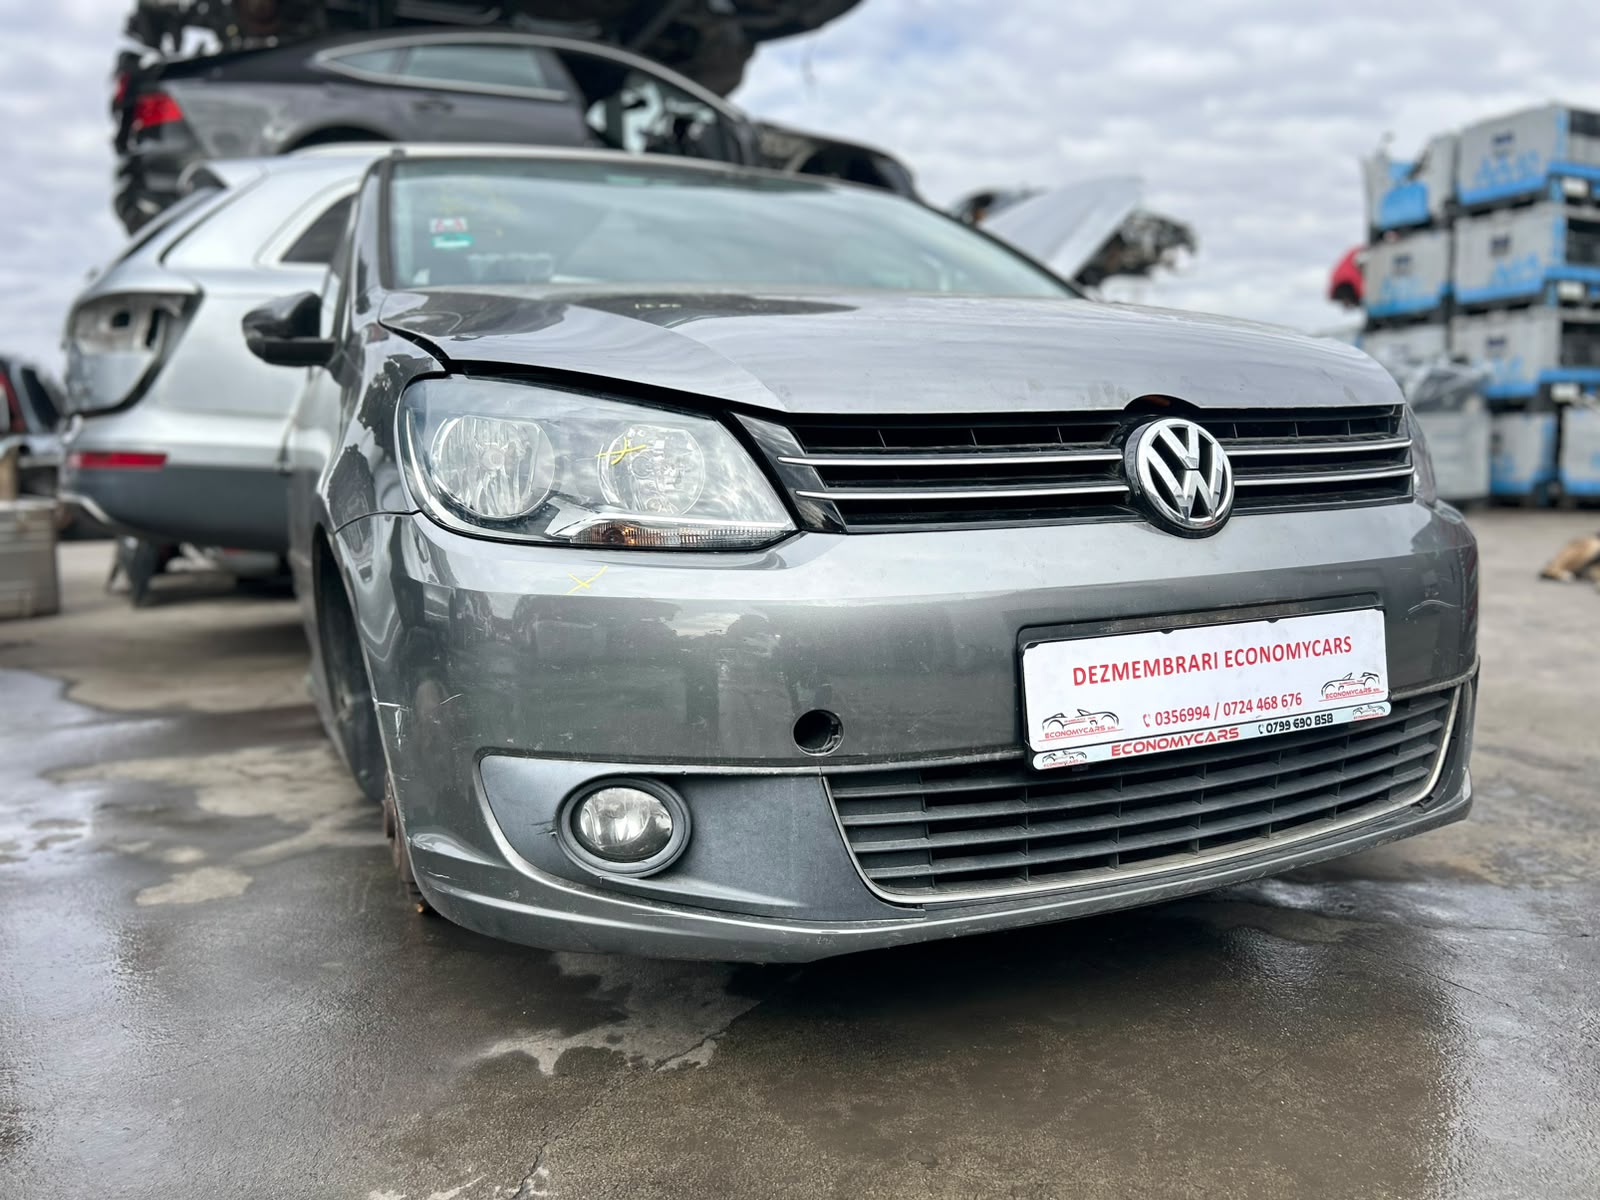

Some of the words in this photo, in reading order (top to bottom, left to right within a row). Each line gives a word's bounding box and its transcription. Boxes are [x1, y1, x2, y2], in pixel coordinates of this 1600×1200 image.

[1137, 418, 1232, 527] VW
[1073, 651, 1218, 686] DEZMEMBRARI
[1224, 635, 1352, 669] ECONOMYCARS
[1325, 687, 1372, 699] ECONOMYCARS
[1155, 705, 1210, 726] 0356994
[1213, 702, 1220, 721] /
[1223, 699, 1253, 716] 0724
[1256, 695, 1278, 711] 468
[1281, 692, 1302, 708] 676
[1266, 720, 1291, 734] 0799
[1293, 716, 1312, 729] 690
[1314, 713, 1334, 726] 858
[1044, 725, 1106, 739] ECONOMYCARS
[1111, 727, 1239, 757] ECONOMYCARS
